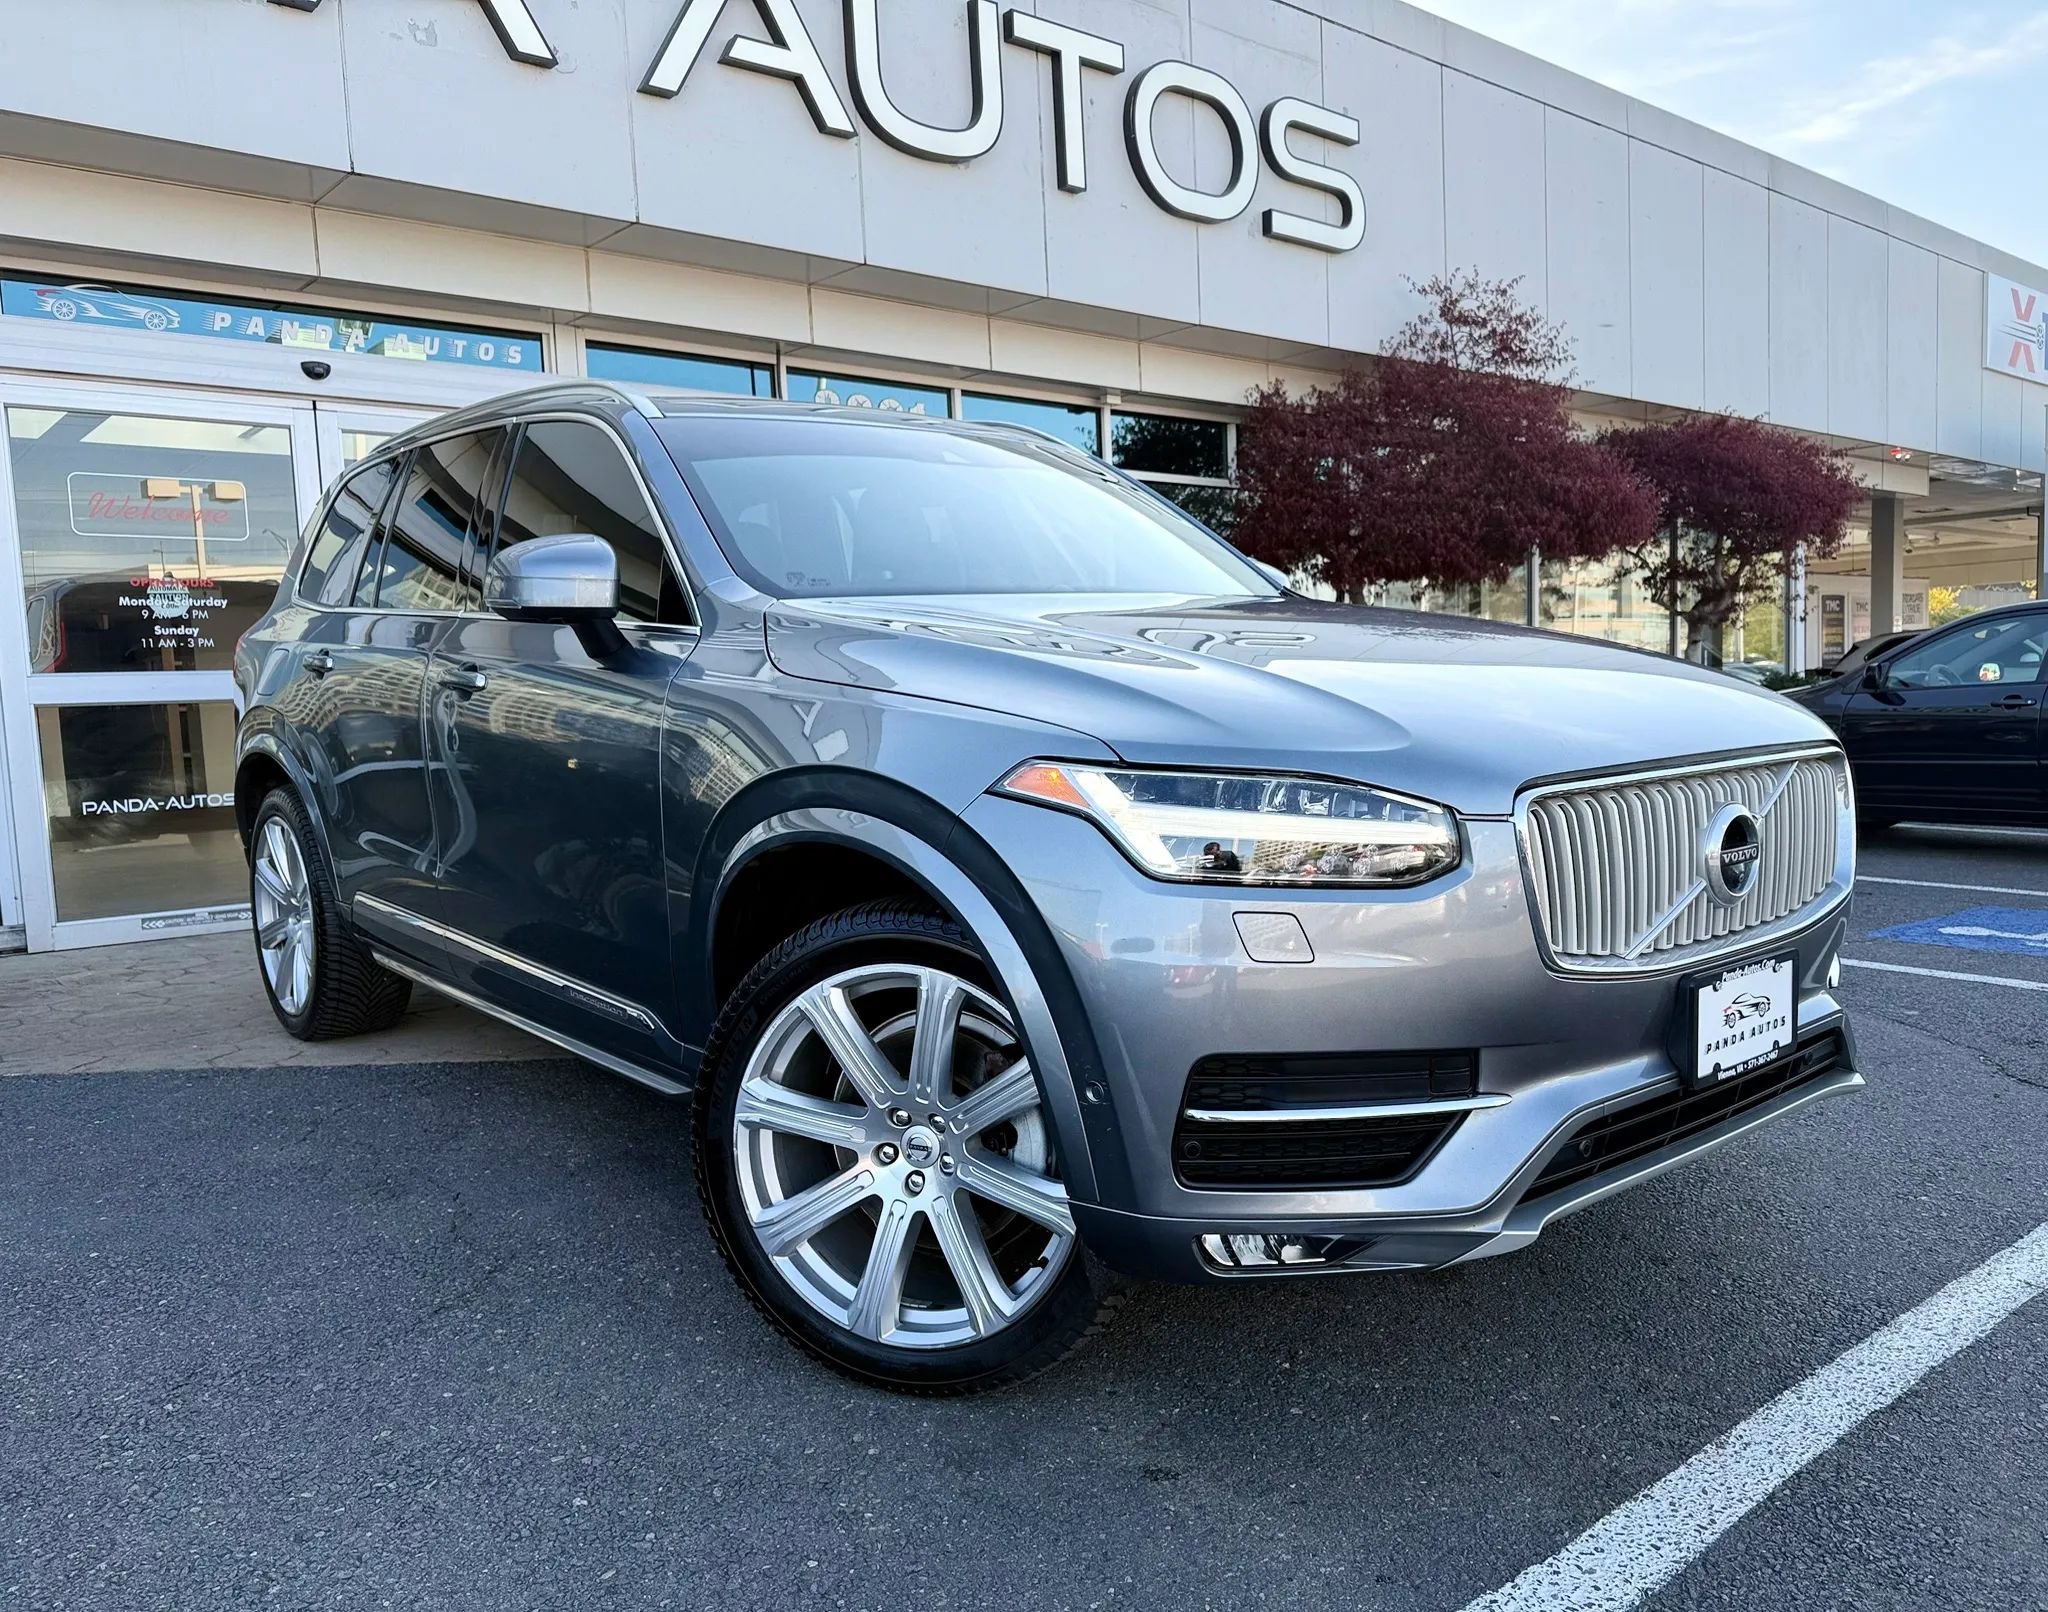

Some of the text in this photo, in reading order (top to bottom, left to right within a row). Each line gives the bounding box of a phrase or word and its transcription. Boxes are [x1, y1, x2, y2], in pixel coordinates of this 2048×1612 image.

[638, 0, 1367, 252] AUTOS
[210, 311, 523, 365] PANDA AUTOS
[88, 492, 230, 525] Welcome
[141, 609, 209, 619] 9 AM 6 PM
[154, 625, 200, 637] Sunday
[142, 638, 154, 648] 11
[158, 639, 177, 648] AM
[187, 638, 195, 648] 3
[198, 639, 215, 648] PM
[82, 794, 235, 815] PANDA-AUTOS
[1722, 847, 1757, 863] VOLVO
[1705, 1015, 1786, 1055] PANDA AUTOS
